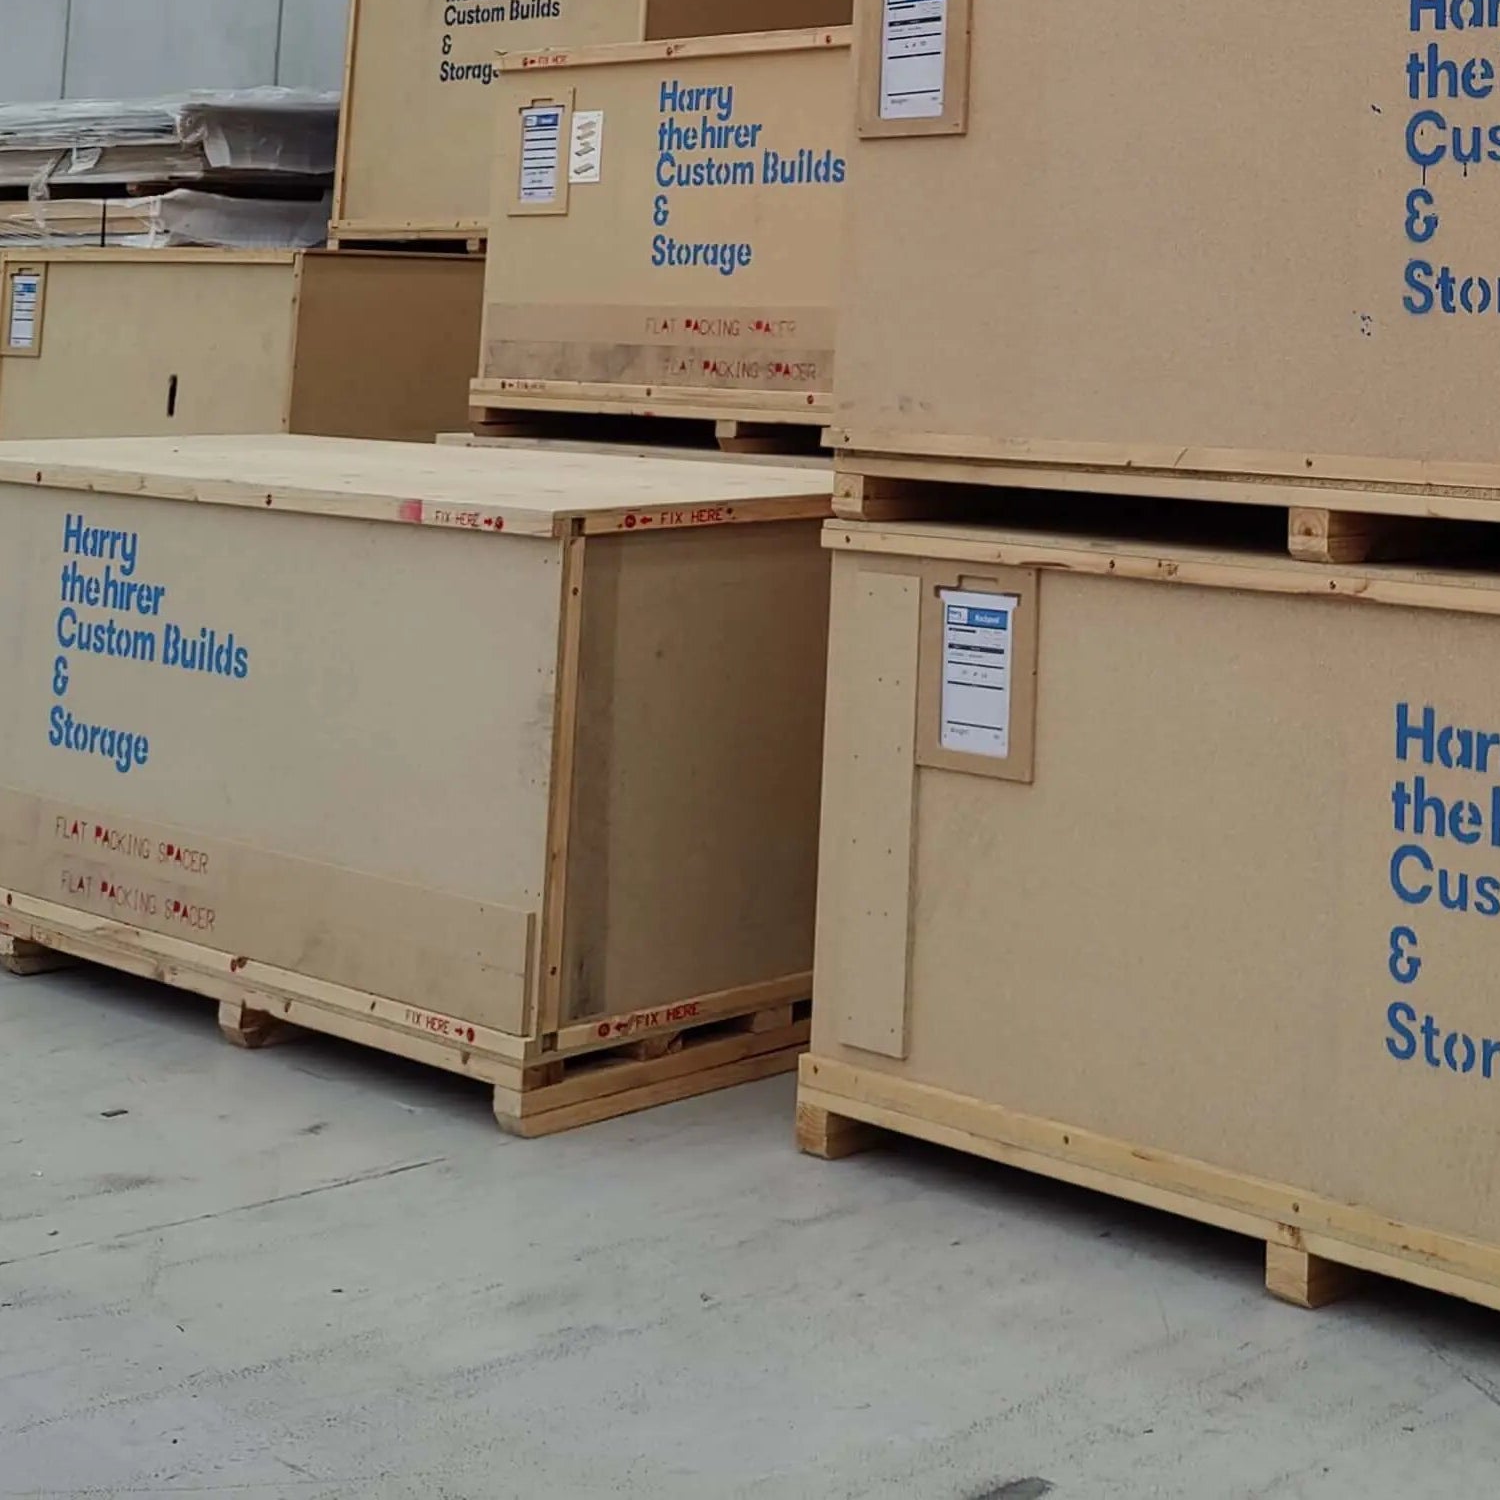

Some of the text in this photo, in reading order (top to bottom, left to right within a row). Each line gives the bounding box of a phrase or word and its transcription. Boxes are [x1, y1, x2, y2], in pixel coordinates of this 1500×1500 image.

[445, 5, 504, 26] Custom
[442, 35, 451, 55] &
[660, 80, 733, 121] Harry
[656, 148, 845, 187] Custom Builds
[653, 195, 669, 226] &
[1405, 188, 1437, 243] &
[652, 234, 752, 276] Storage
[646, 318, 675, 335] FLAT
[684, 319, 740, 338] PACKING
[702, 359, 759, 380] PACKING
[767, 362, 817, 381] SPACER
[435, 509, 480, 527] FIX HERE
[661, 508, 724, 524] FIX HERE
[64, 514, 137, 575] Harry
[57, 607, 249, 679] Custom Builds
[53, 656, 68, 695] &
[49, 705, 148, 773] Storage
[55, 816, 209, 875] FLAT PACKING SPACER
[60, 870, 216, 931] FLAT PACKING SPACER
[1389, 927, 1420, 984] &
[404, 1008, 449, 1035] FIX HERE
[636, 1002, 700, 1028] FIX HERE
